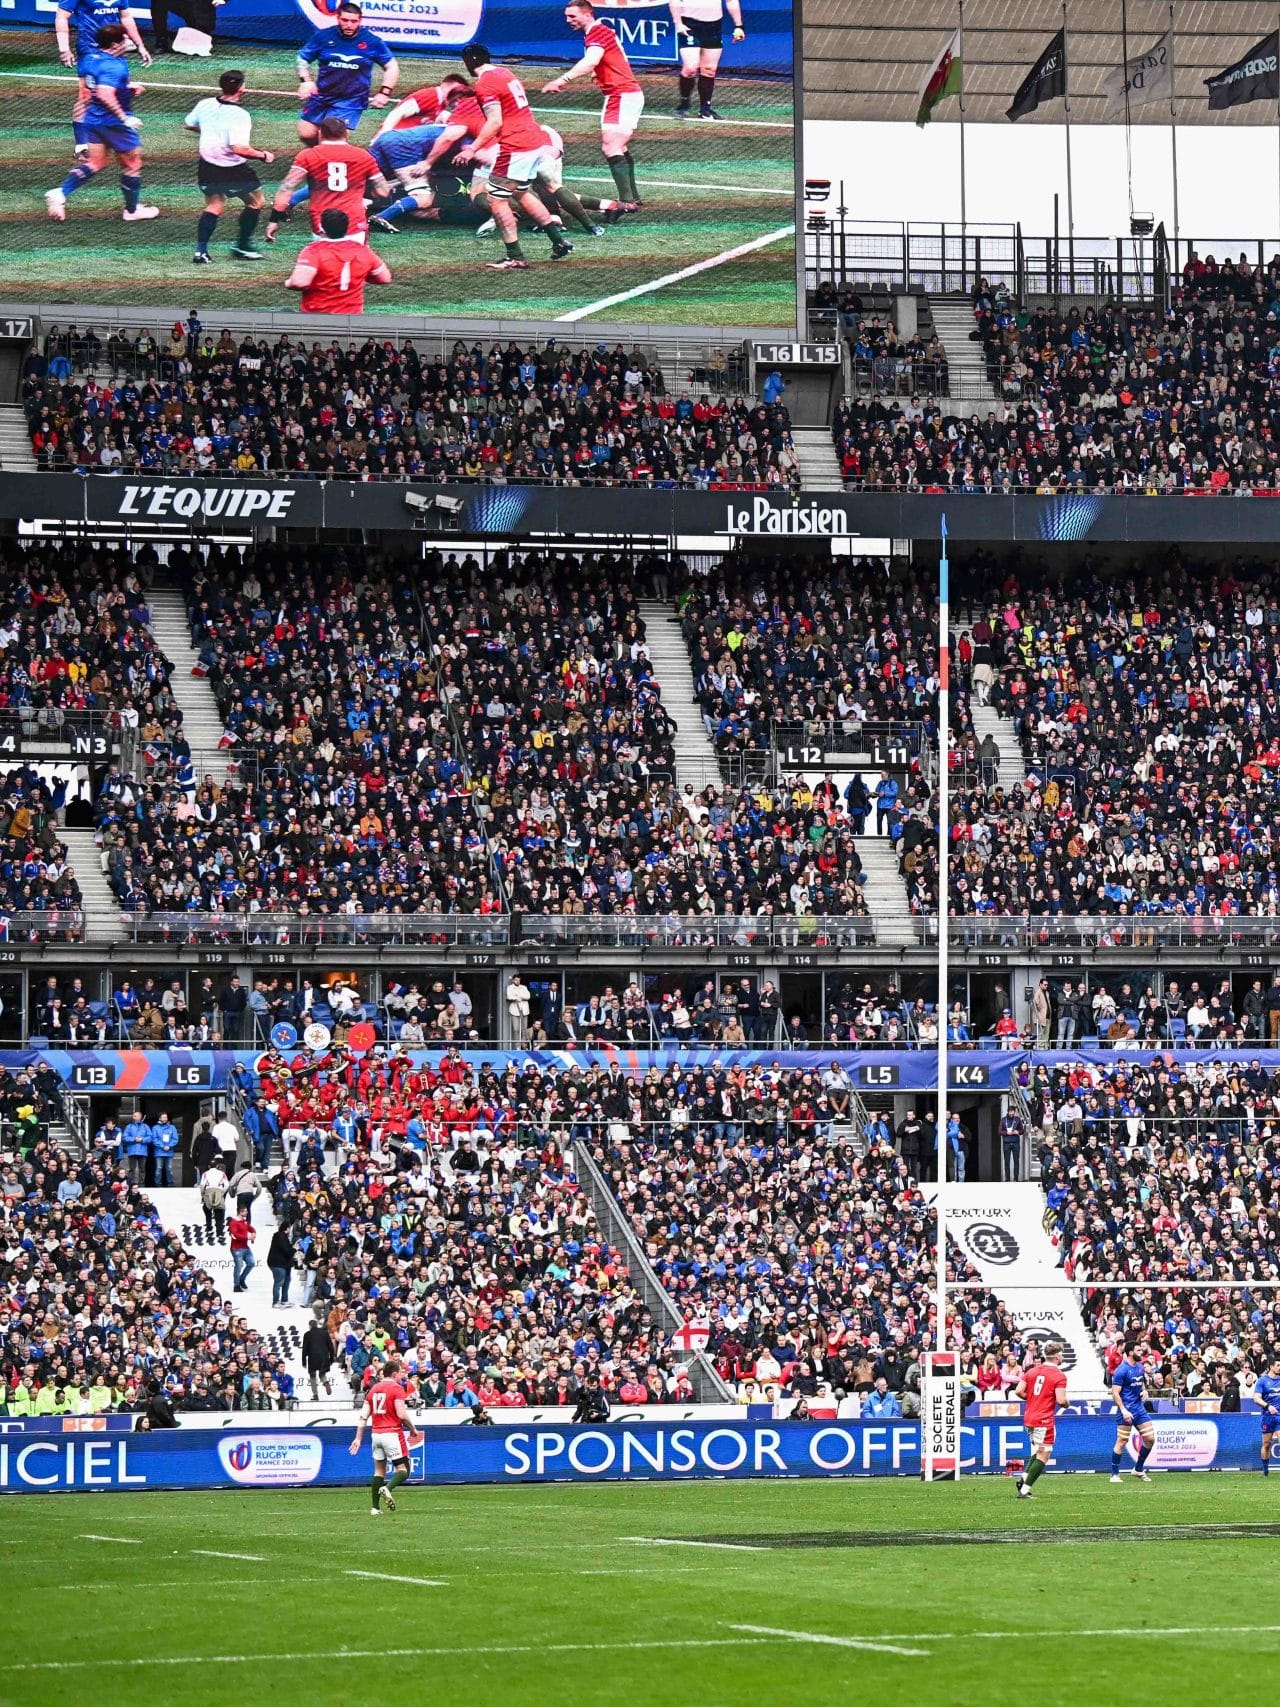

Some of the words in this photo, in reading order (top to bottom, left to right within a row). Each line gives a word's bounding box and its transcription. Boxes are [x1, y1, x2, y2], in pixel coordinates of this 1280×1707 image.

[409, 4, 439, 15] 2023
[328, 62, 359, 70] ALTRAD
[327, 162, 348, 192] 8
[339, 261, 351, 291] 1
[0, 321, 27, 337] 17
[727, 505, 748, 533] Le
[753, 496, 848, 534] Parisien
[205, 954, 222, 963] 119
[268, 954, 285, 963] 118
[472, 955, 489, 964] 117
[534, 955, 551, 964] 116
[734, 955, 750, 964] 115
[794, 955, 810, 964] 114
[985, 956, 1001, 964] 113
[1058, 956, 1074, 964] 112
[1247, 956, 1262, 964] 111
[76, 1067, 107, 1084] L13
[177, 1067, 200, 1083] L6
[866, 1066, 892, 1084] L5
[955, 1066, 984, 1084] K4
[1011, 1311, 1064, 1321] NTURY
[1033, 1375, 1045, 1396] 6
[372, 1392, 386, 1414] 12
[933, 1395, 942, 1453] SOCIETE
[946, 1382, 955, 1453] GENERALE
[255, 1451, 288, 1459] RUGBY
[504, 1429, 788, 1475] SPONSOR
